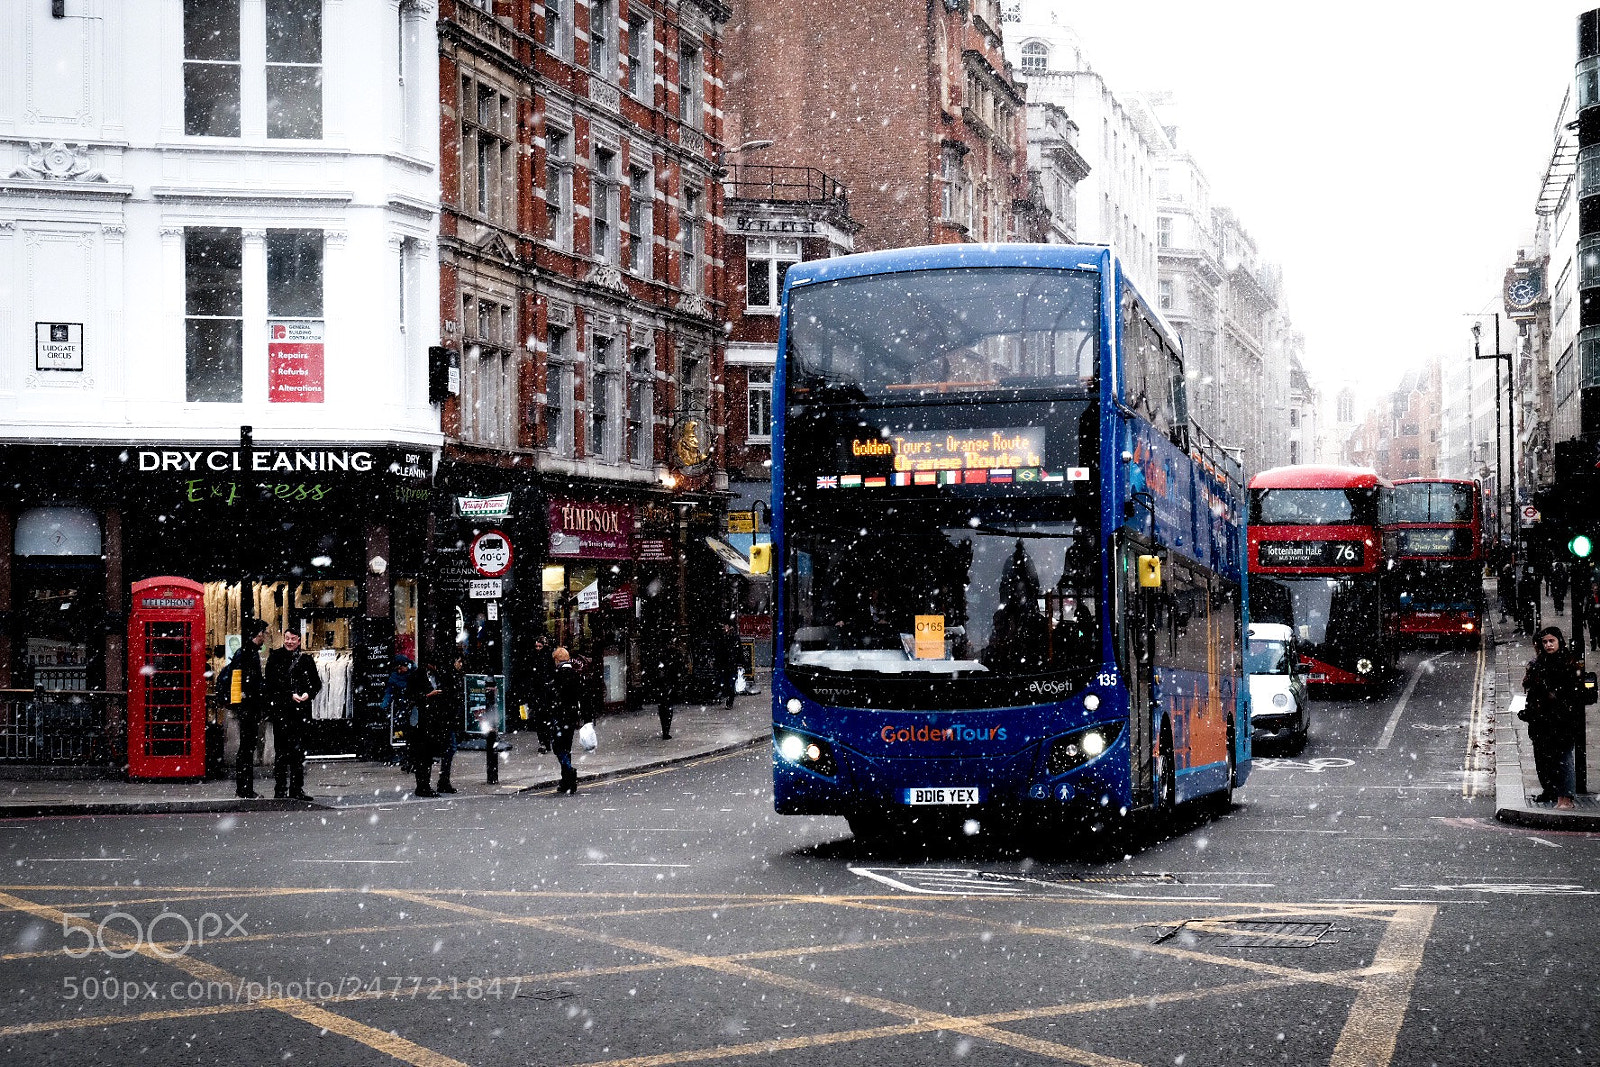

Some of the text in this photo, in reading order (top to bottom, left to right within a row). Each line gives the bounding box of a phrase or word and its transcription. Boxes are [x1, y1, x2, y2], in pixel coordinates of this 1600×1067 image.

[278, 351, 308, 360] Repairs
[278, 367, 309, 376] Refurbs
[278, 384, 322, 392] Alterations
[852, 439, 891, 456] Golden
[895, 437, 931, 454] Tours
[946, 436, 989, 452] Orange
[993, 433, 1029, 451] Route
[138, 451, 203, 471] DRY
[405, 454, 420, 464] DRY
[894, 454, 962, 471] Orange
[966, 451, 1022, 469] Route
[561, 506, 619, 532] TIMPSON
[1268, 545, 1354, 560] Tottenham Hale 76
[143, 598, 195, 606] TELEPHONE
[1098, 673, 1117, 687] 135
[813, 687, 850, 697] VOLVO
[880, 724, 1008, 744] GoldenTours
[915, 789, 975, 803] BD16 YEX
